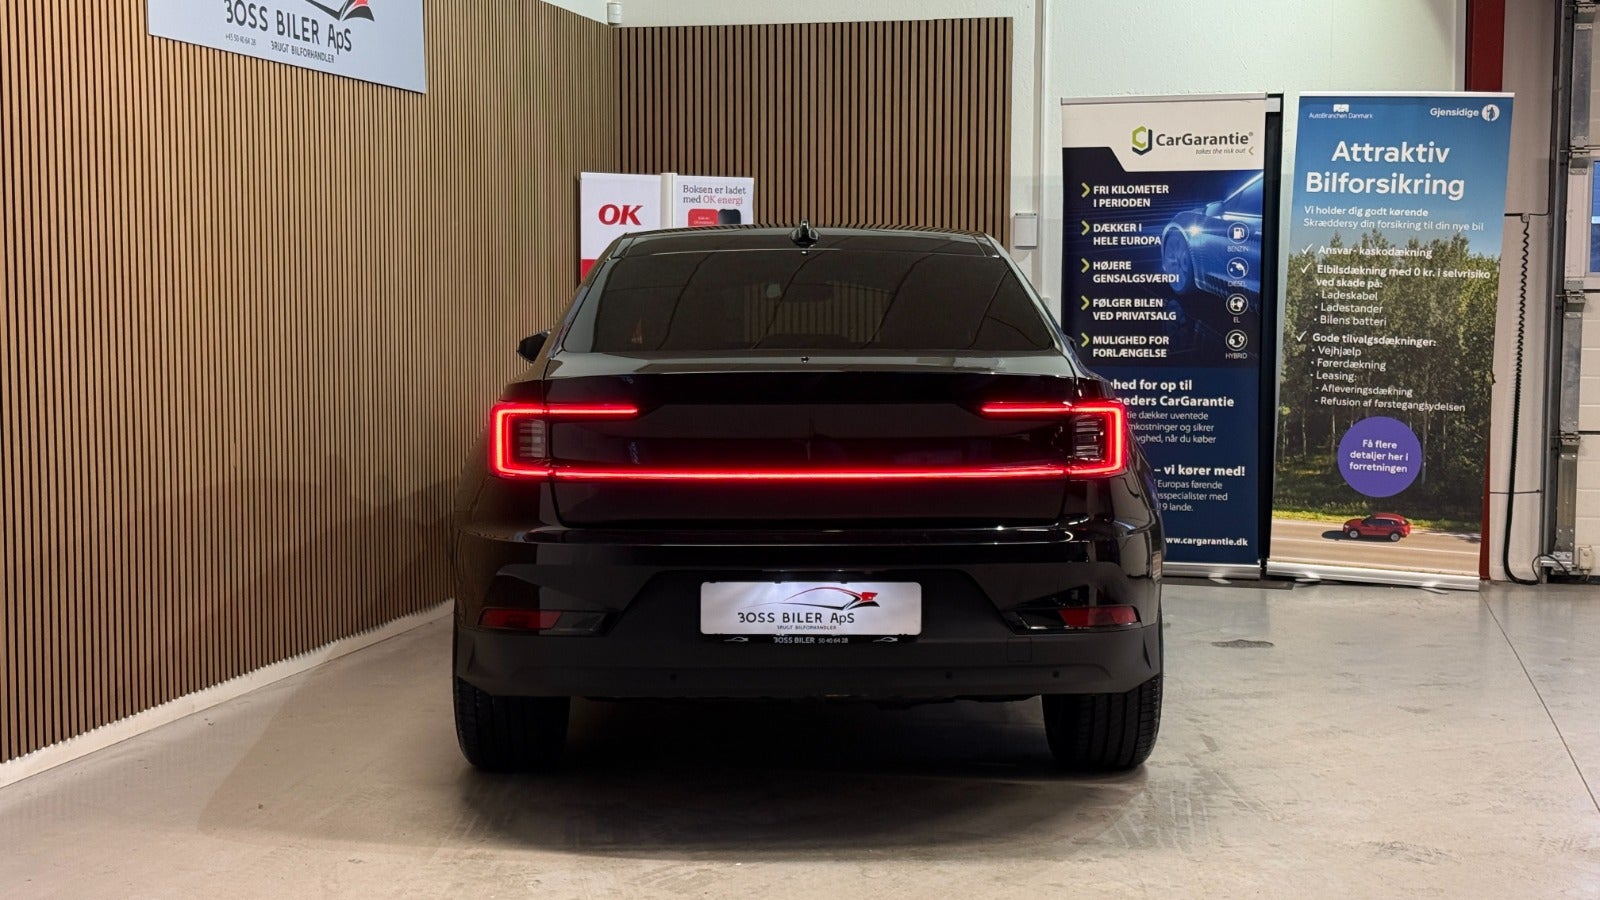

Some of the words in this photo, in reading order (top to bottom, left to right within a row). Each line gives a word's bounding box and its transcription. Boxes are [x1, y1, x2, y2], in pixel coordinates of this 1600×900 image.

[276, 10, 320, 44] BILER
[328, 23, 352, 55] ApS
[291, 45, 335, 63] BILFORHANDLER
[1429, 107, 1479, 118] Gjensidige
[1331, 140, 1450, 163] Attraktiv
[682, 184, 713, 194] Boksen
[725, 185, 747, 195] ladet
[1093, 185, 1109, 194] FRI
[1111, 184, 1169, 194] KILOMETER
[1306, 171, 1465, 201] Bilforsikring
[682, 195, 701, 204] med
[703, 195, 716, 204] OK
[717, 197, 743, 206] energi
[1093, 199, 1097, 207] I
[1099, 198, 1151, 207] PERIODEN
[598, 204, 643, 226] OK
[1304, 206, 1314, 214] Vi
[1316, 206, 1346, 215] holder
[1348, 207, 1363, 217] dig
[1364, 207, 1387, 217] godt
[1389, 208, 1428, 217] kørende
[1093, 223, 1137, 232] DÆKKER
[1138, 223, 1142, 232] I
[1303, 217, 1358, 230] Skræddersy
[1360, 219, 1375, 228] din
[1377, 220, 1421, 231] forsikring
[1423, 221, 1433, 230] til
[1435, 222, 1450, 230] din
[1452, 224, 1469, 232] nye
[1471, 222, 1484, 231] bil
[1093, 236, 1118, 245] HELE
[1120, 236, 1162, 245] EUROPA
[1226, 245, 1249, 253] BENZIN
[1359, 246, 1433, 259] kaskodækning
[1092, 261, 1132, 270] HØJERE
[1317, 265, 1387, 278] Elbilsdækning
[1389, 268, 1412, 277] med
[1414, 268, 1421, 277] 0
[1423, 268, 1435, 277] kr.
[1437, 268, 1441, 277] i
[1443, 268, 1491, 279] selvrisiko
[1092, 274, 1179, 283] GENSALGSVÆRDI
[1316, 279, 1335, 287] ved
[1336, 279, 1365, 288] skade
[1367, 279, 1382, 290] på:
[1321, 290, 1378, 301] Ladeskabel
[1092, 298, 1132, 308] FØLGER
[1134, 298, 1163, 308] BILEN
[1320, 302, 1383, 314] Ladestander
[1092, 311, 1113, 320] VED
[1115, 311, 1177, 320] PRIVATSALG
[1320, 315, 1350, 325] Bilens
[1353, 316, 1387, 326] batteri
[1092, 335, 1147, 345] MULIGHED
[1149, 335, 1169, 345] FOR
[1312, 333, 1340, 343] Gode
[1342, 334, 1437, 347] tilvalgsdækninger:
[1092, 348, 1167, 358] FORLÆNGELSE
[1318, 345, 1362, 357] Vejhjælp
[1317, 358, 1387, 371] Førerdækning
[1316, 371, 1357, 382] Leasing:
[1110, 379, 1137, 390] hed
[1139, 379, 1157, 390] for
[1160, 382, 1176, 392] op
[1179, 379, 1192, 390] til
[1321, 383, 1413, 397] Afleveringsdækning
[1160, 396, 1234, 407] CarGarantie
[1320, 397, 1361, 407] Refusion
[1362, 399, 1372, 408] af
[1374, 399, 1466, 412] førstegangsydelsen
[1126, 410, 1137, 419] tie
[1138, 410, 1168, 419] dækker
[1170, 411, 1208, 420] uventede
[1179, 424, 1191, 433] og
[1192, 422, 1214, 432] sikrer
[1165, 433, 1178, 443] når
[1179, 433, 1191, 443] du
[1192, 434, 1216, 444] køber
[1362, 439, 1373, 448] Få
[1375, 440, 1398, 449] flere
[1349, 450, 1387, 461] detaljer
[1388, 452, 1404, 461] her
[1405, 453, 1409, 461] i
[1164, 464, 1177, 475] vi
[1178, 464, 1211, 476] kører
[1214, 465, 1245, 477] med!
[1349, 461, 1408, 474] forretningen
[1157, 480, 1189, 490] Europas
[1191, 479, 1223, 489] førende
[1209, 492, 1228, 501] med
[1169, 502, 1193, 511] lande.
[1165, 536, 1248, 547] ww.cargarantie.dk
[782, 612, 822, 623] BILER
[830, 612, 855, 625] ApS
[794, 636, 815, 644] BILER
